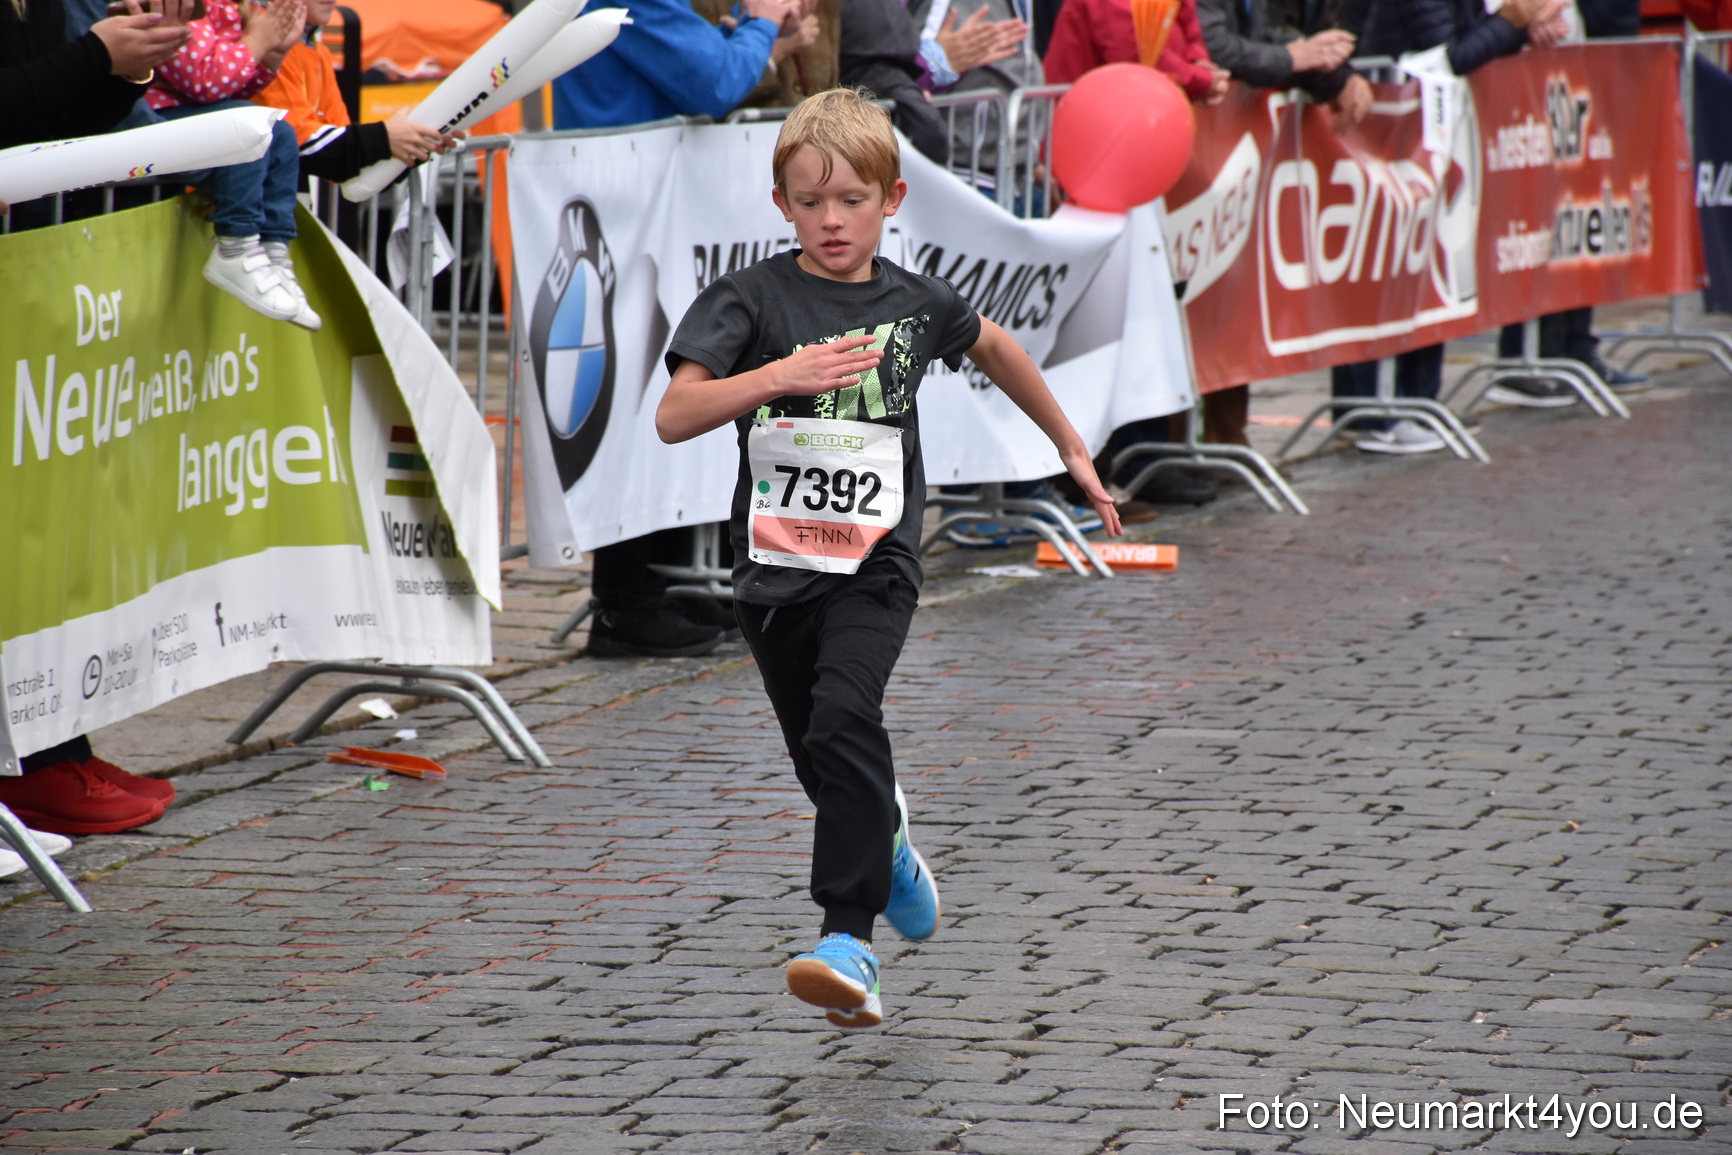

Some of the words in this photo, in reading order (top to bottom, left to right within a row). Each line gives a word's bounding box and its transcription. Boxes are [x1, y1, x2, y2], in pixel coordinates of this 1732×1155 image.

[73, 284, 122, 347] Der
[13, 354, 136, 467] Neue
[810, 433, 865, 450] BOCK
[774, 464, 882, 517] 7392
[48, 669, 54, 687] 1
